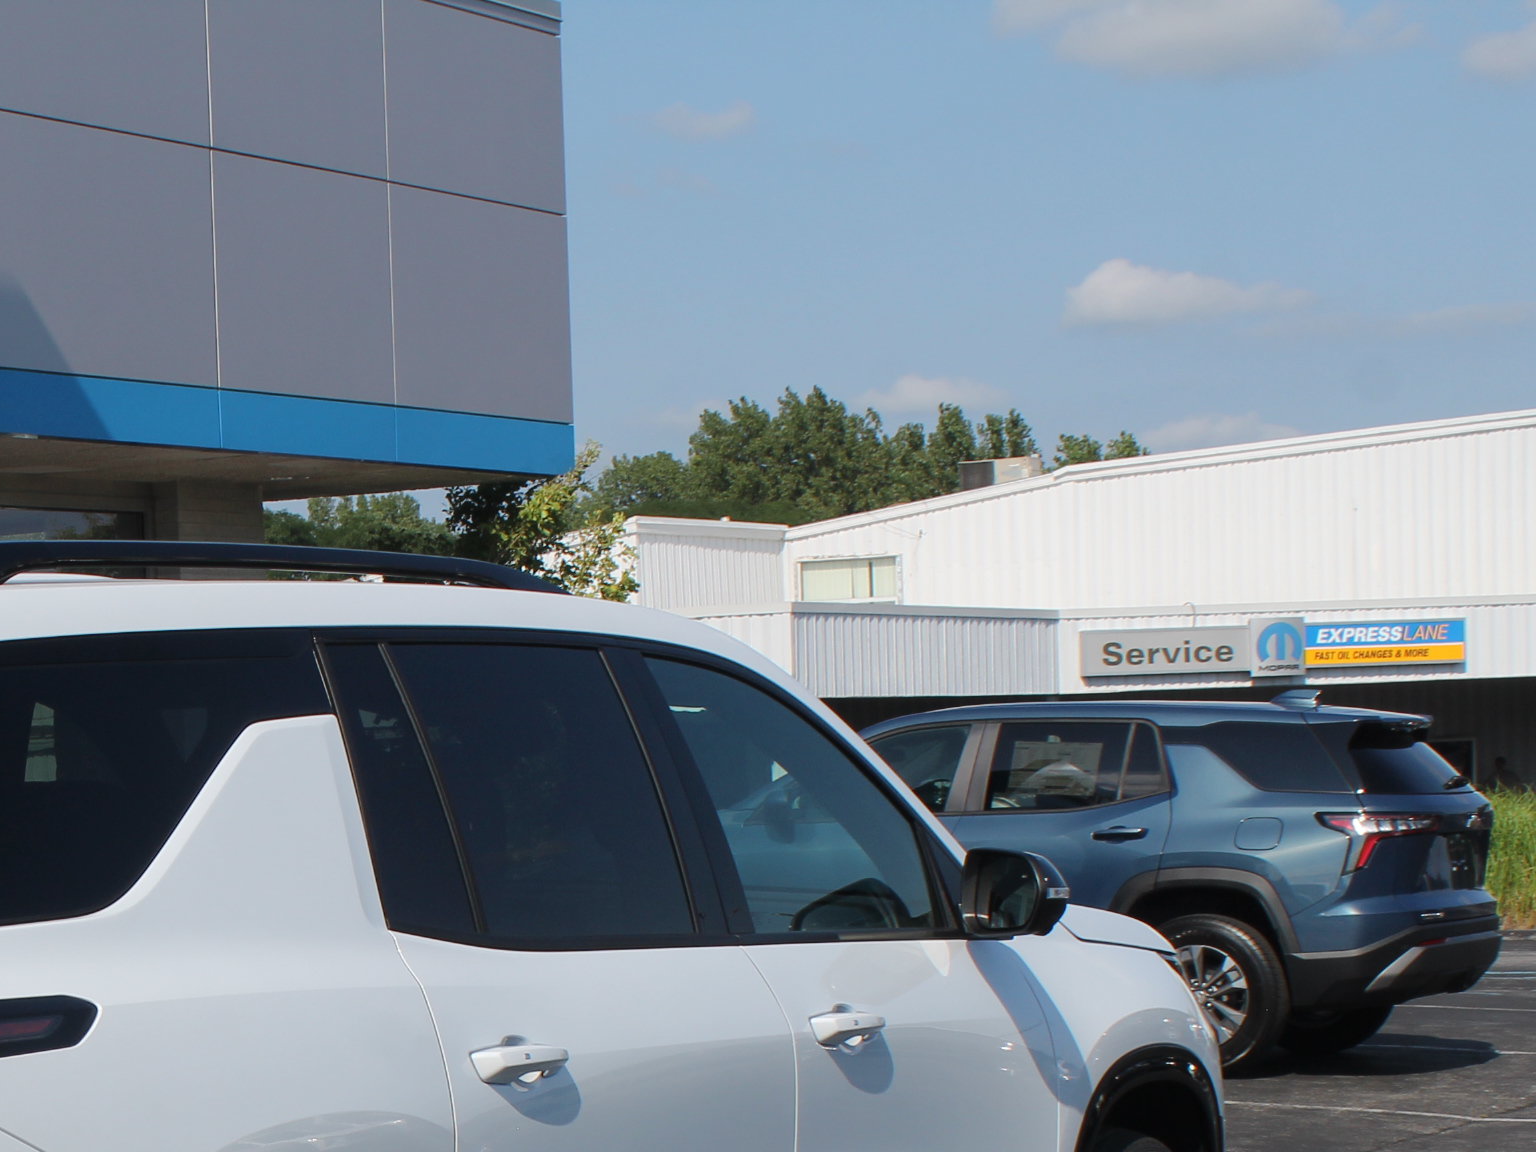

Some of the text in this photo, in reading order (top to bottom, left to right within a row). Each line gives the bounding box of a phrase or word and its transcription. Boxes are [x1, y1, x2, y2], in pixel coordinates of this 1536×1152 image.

[1102, 640, 1234, 666] Service
[1315, 649, 1430, 660] FAST OIL CHANGES & MORE
